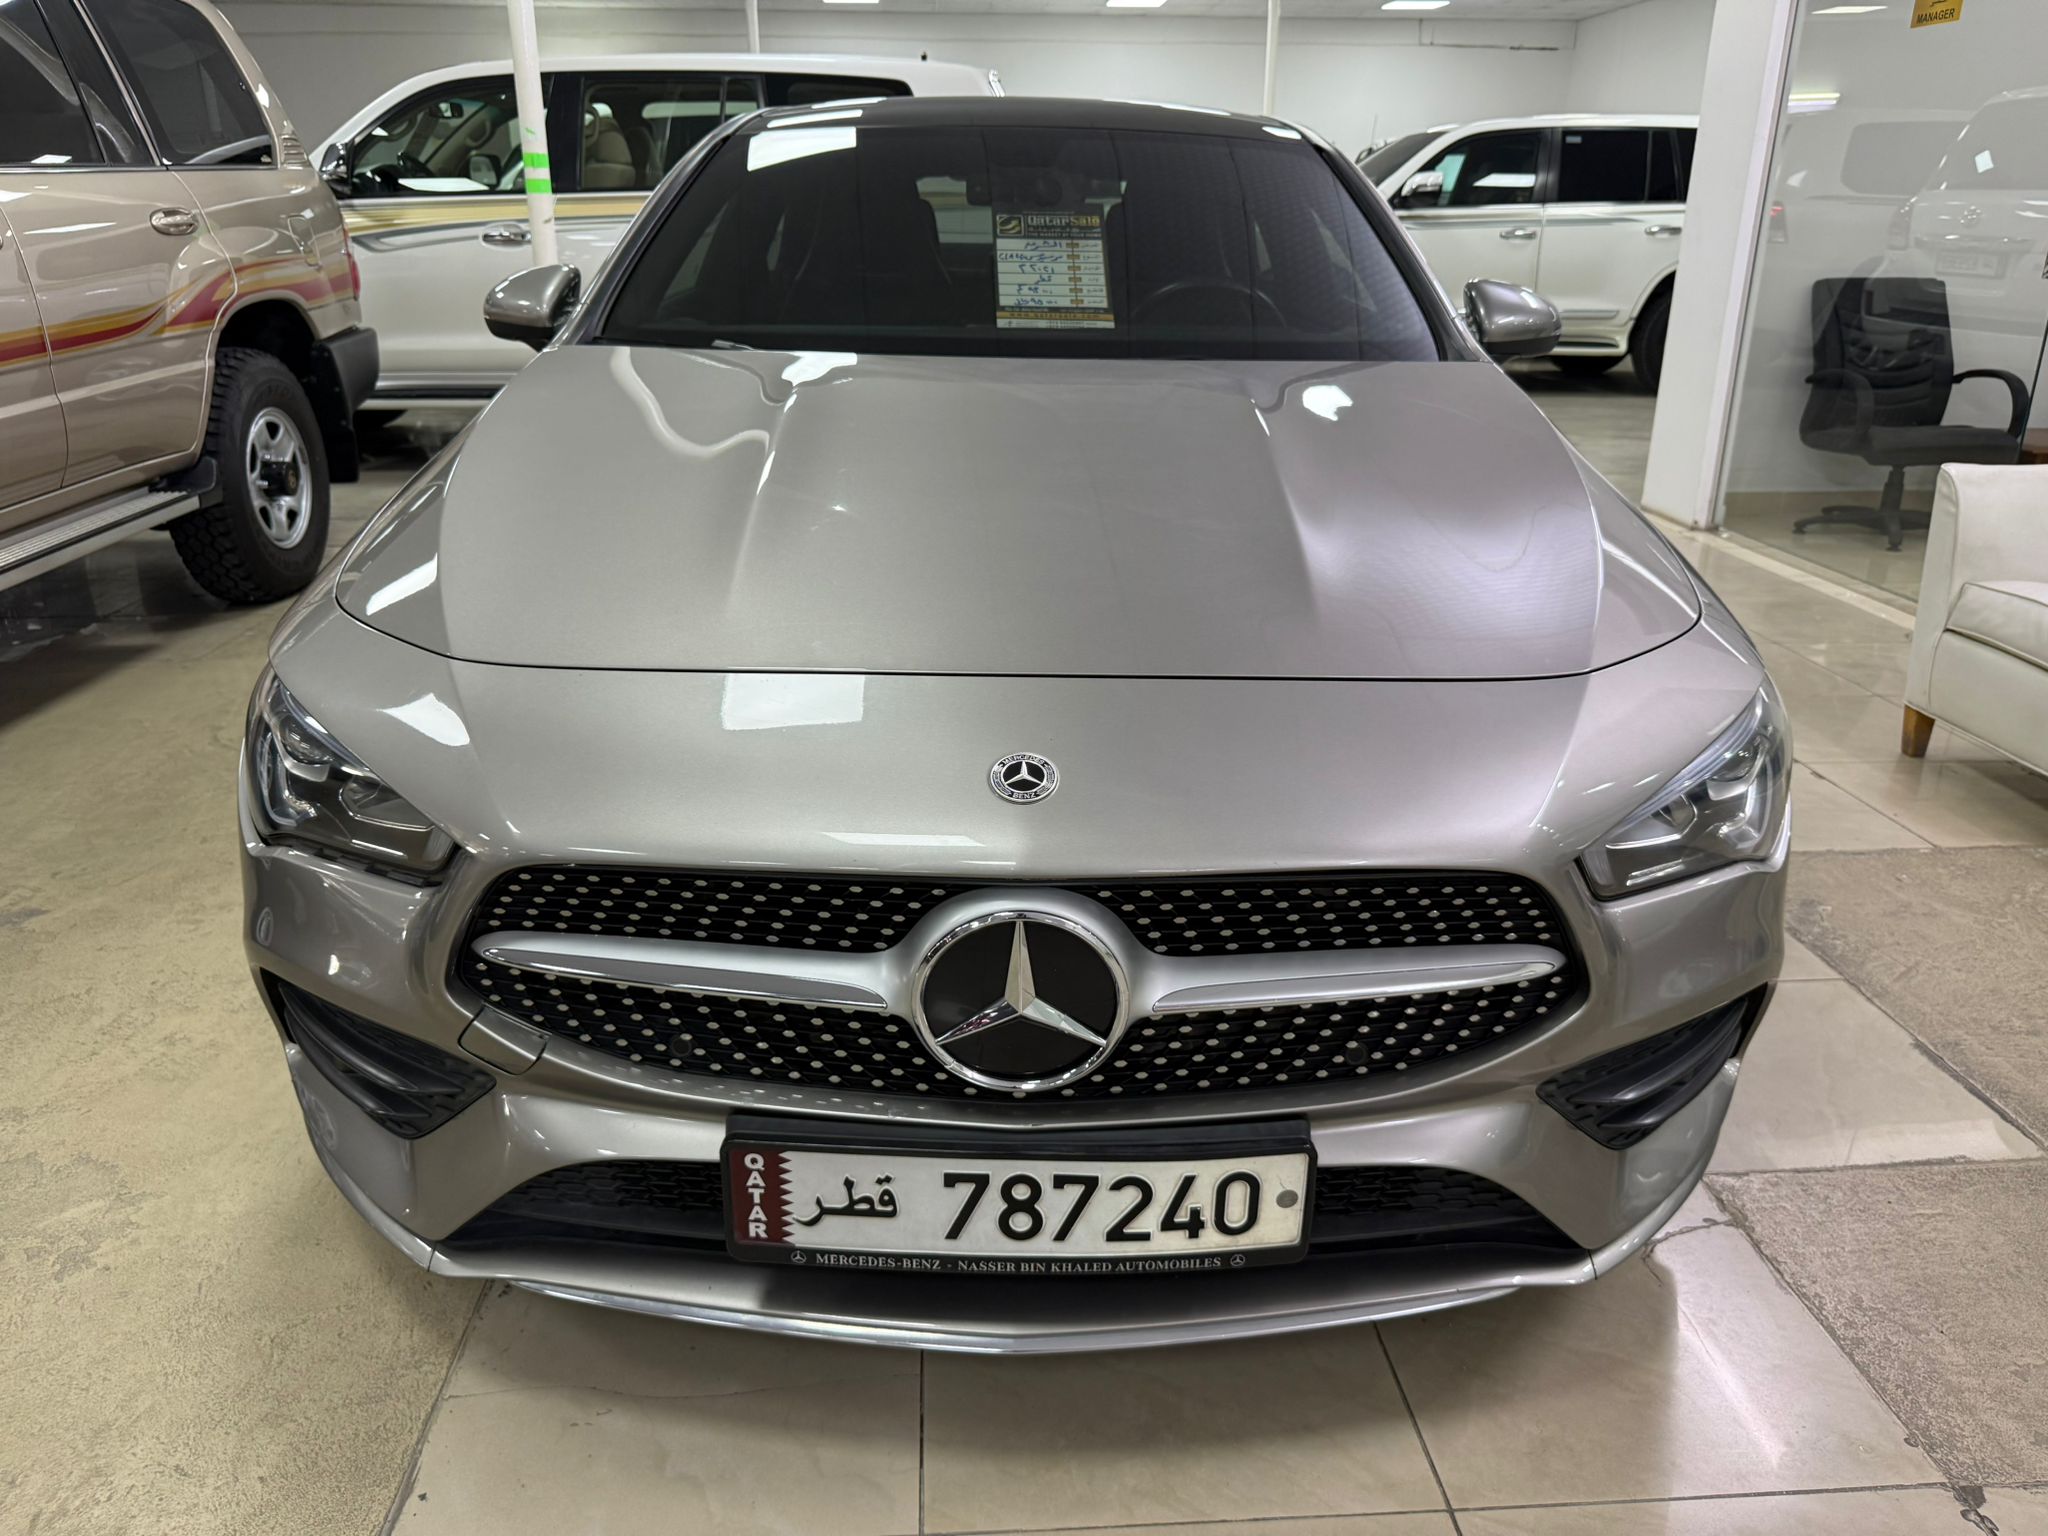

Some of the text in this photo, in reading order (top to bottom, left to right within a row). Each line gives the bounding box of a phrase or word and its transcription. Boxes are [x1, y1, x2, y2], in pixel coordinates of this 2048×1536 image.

[1916, 8, 1955, 24] MANAGER
[1002, 754, 1045, 765] MERCEDES
[1013, 791, 1037, 800] BENZ
[744, 1153, 769, 1239] QATAR
[792, 1174, 899, 1226] قطر
[943, 1171, 1261, 1242] 787240
[815, 1253, 941, 1270] MERCEDES-BENZ
[957, 1260, 1016, 1272] NASSER
[1020, 1262, 1046, 1272] BIN
[1051, 1262, 1112, 1272] KHALED
[1115, 1256, 1221, 1272] AUTOMOBILES
